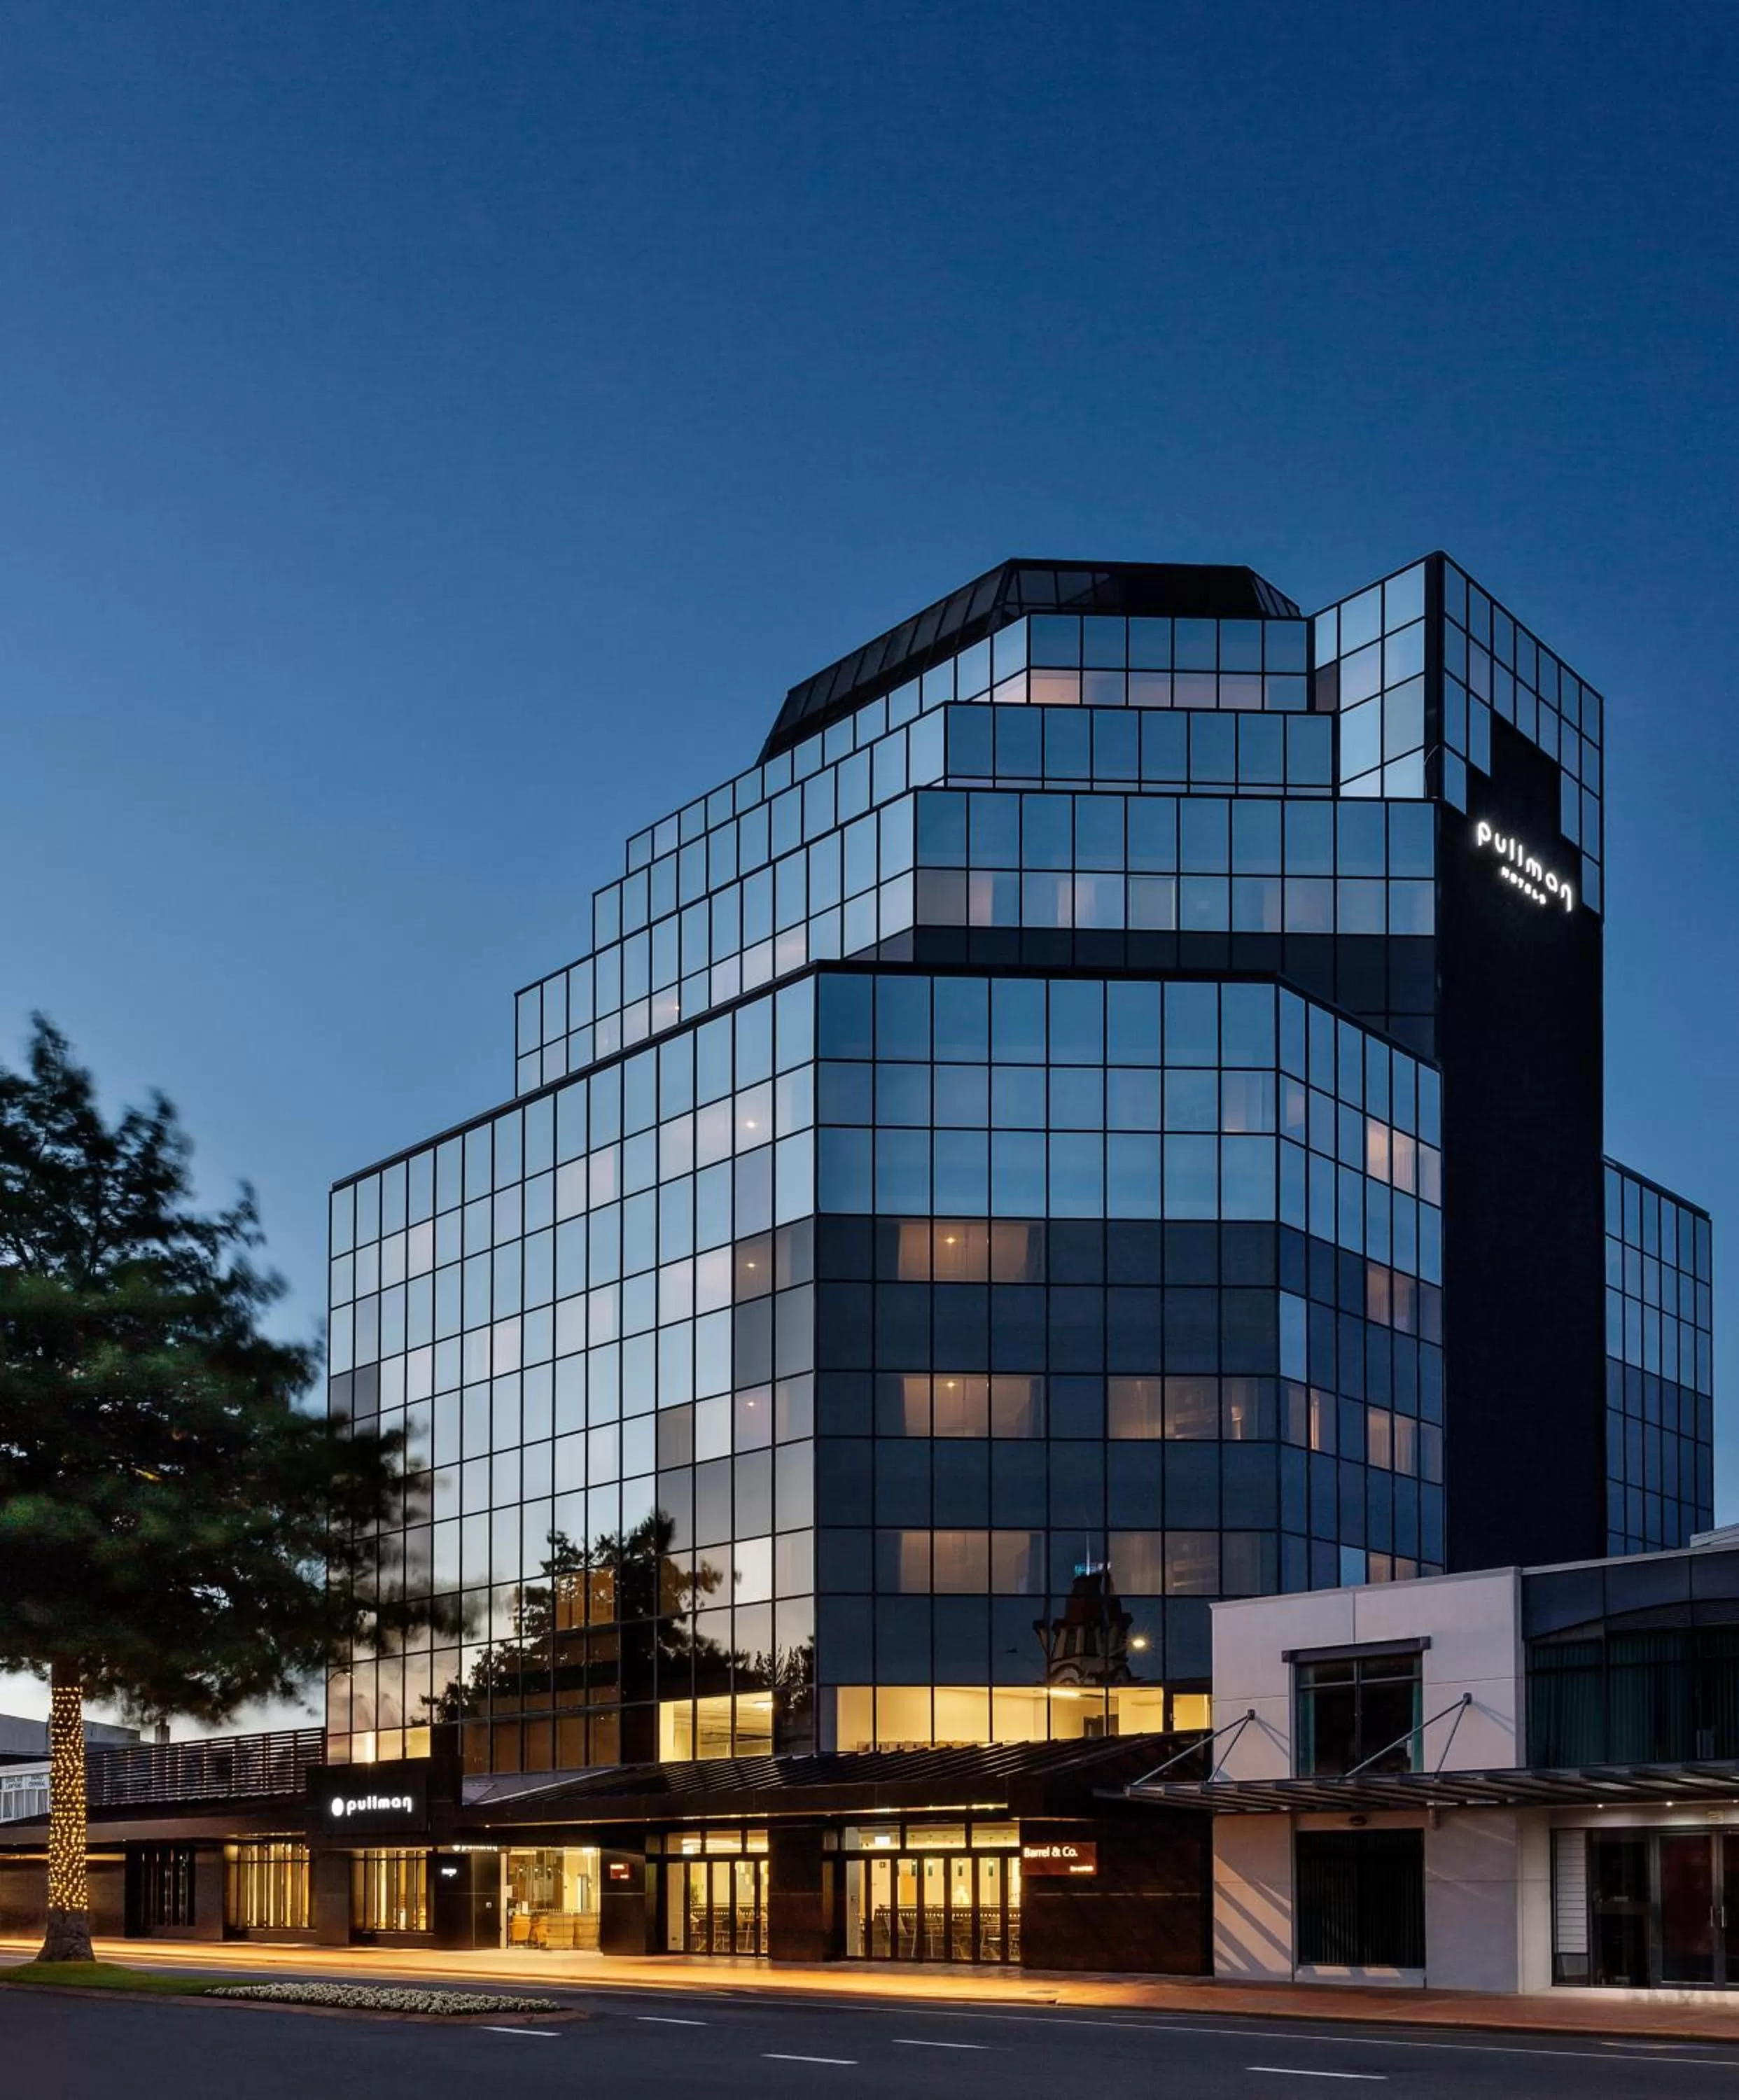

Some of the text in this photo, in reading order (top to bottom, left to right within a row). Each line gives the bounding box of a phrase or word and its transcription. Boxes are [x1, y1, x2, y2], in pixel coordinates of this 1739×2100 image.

[1478, 822, 1572, 912] pullman
[347, 1795, 412, 1816] pullman
[1024, 1846, 1078, 1858] Barrel & Co.
